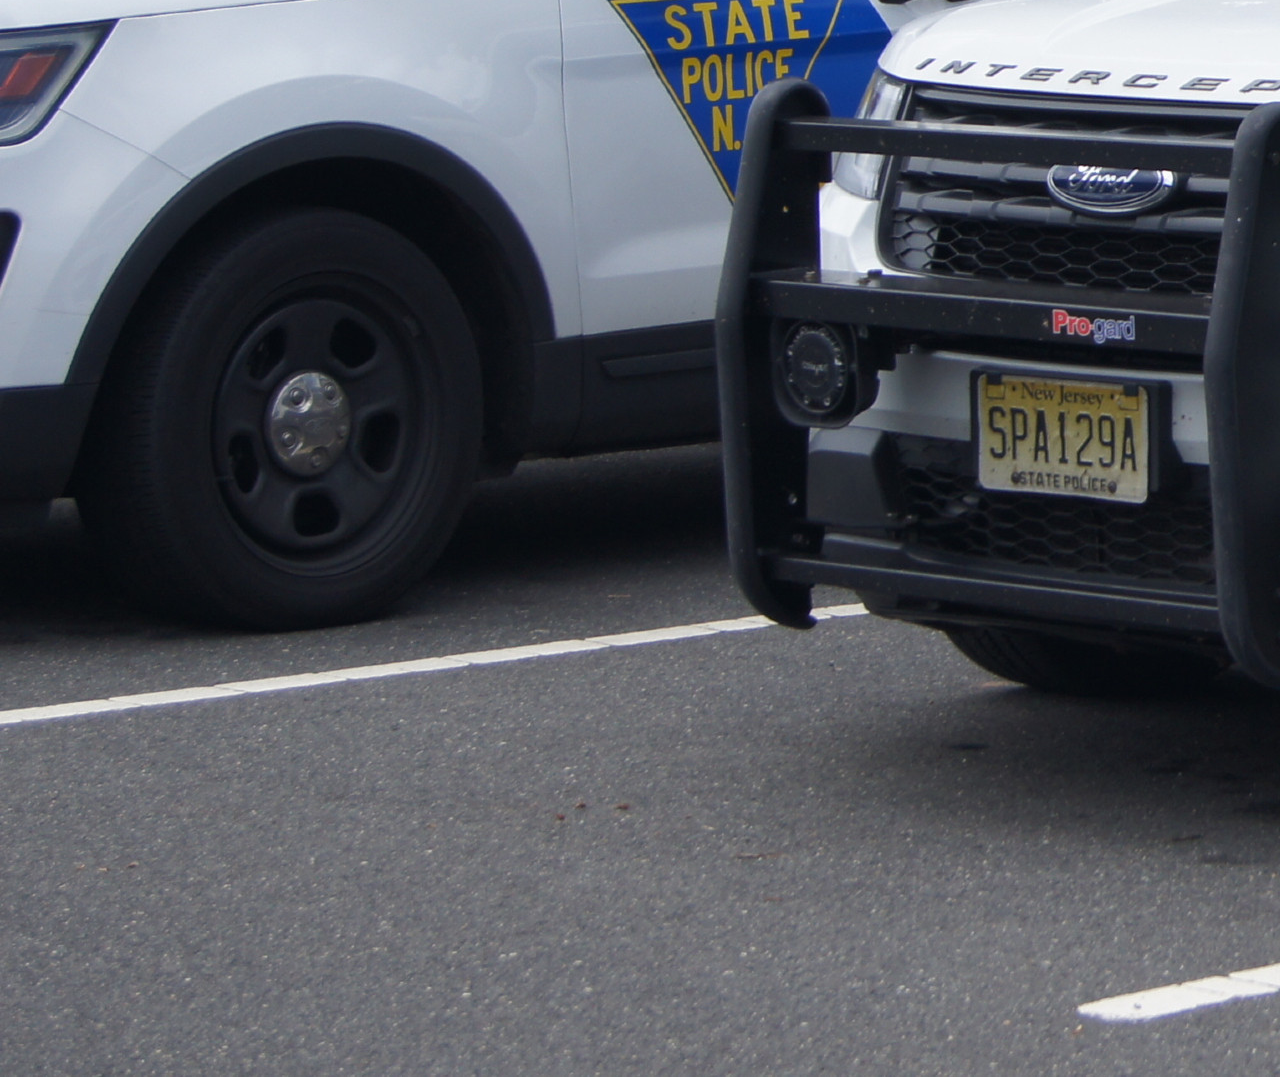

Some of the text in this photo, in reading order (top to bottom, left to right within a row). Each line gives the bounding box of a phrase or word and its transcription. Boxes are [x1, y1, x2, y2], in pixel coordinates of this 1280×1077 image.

[682, 48, 793, 104] POLICE
[1052, 309, 1136, 344] Pro-gard
[1021, 381, 1105, 410] New Jersey
[988, 405, 1137, 472] SPA129A
[1019, 471, 1107, 492] STATE POLICE
